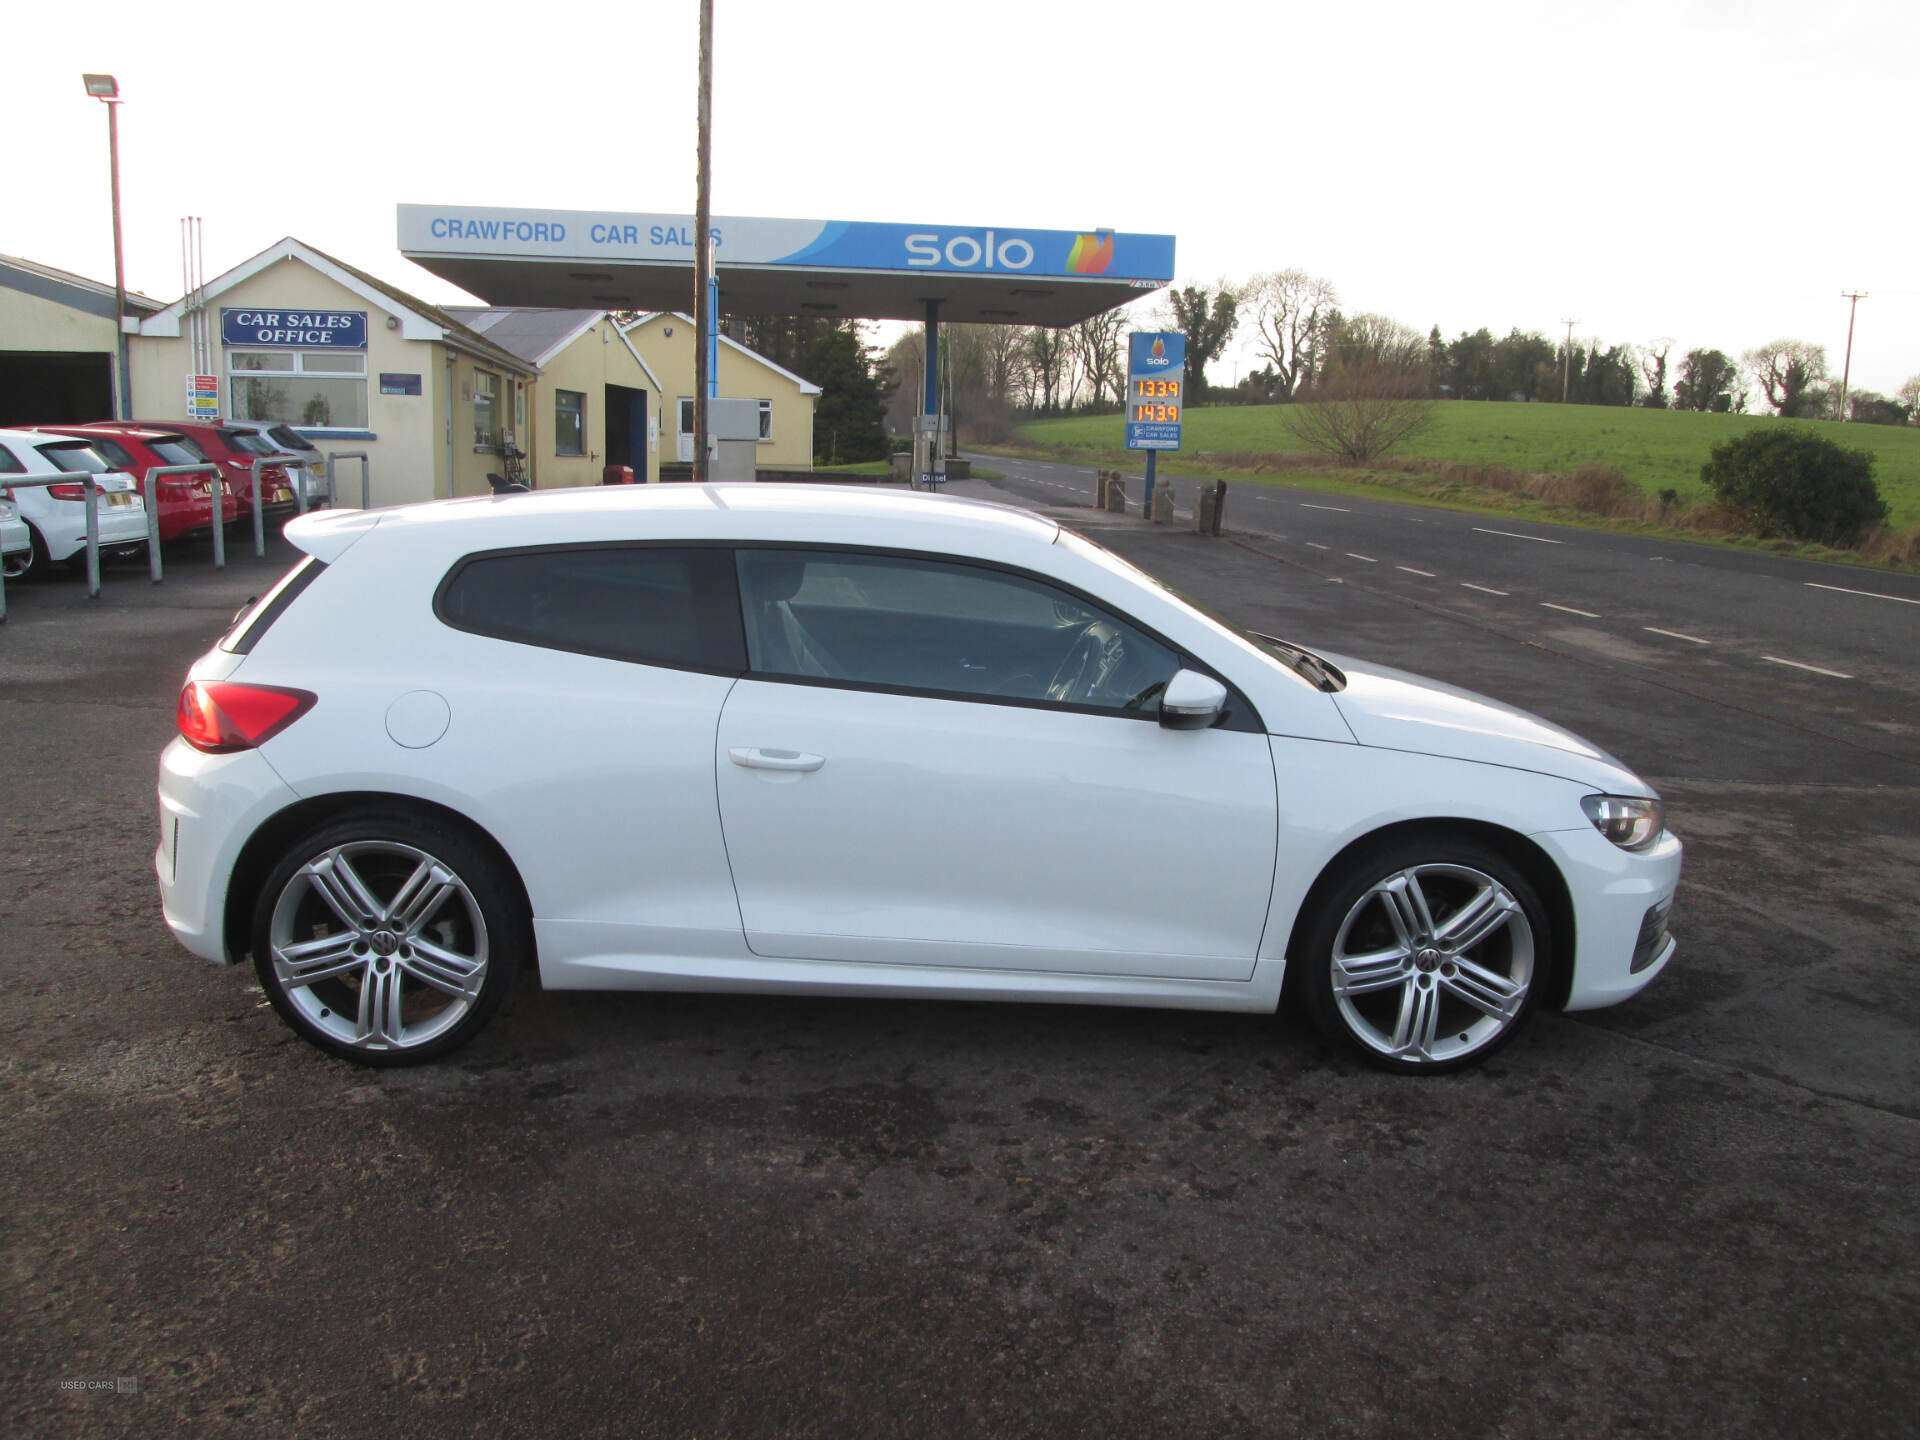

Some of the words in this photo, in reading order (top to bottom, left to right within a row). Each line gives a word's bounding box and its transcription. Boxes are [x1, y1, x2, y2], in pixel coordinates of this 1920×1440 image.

[430, 218, 566, 243] CRAWFORD
[590, 224, 638, 244] CAR
[649, 226, 723, 247] SALS
[904, 230, 1035, 269] solo
[236, 313, 280, 326] CAR
[286, 314, 352, 328] SALES
[257, 329, 333, 343] OFFICE
[1146, 357, 1170, 366] solo
[1138, 380, 1179, 397] 133.9
[1137, 405, 1179, 421] 143.9
